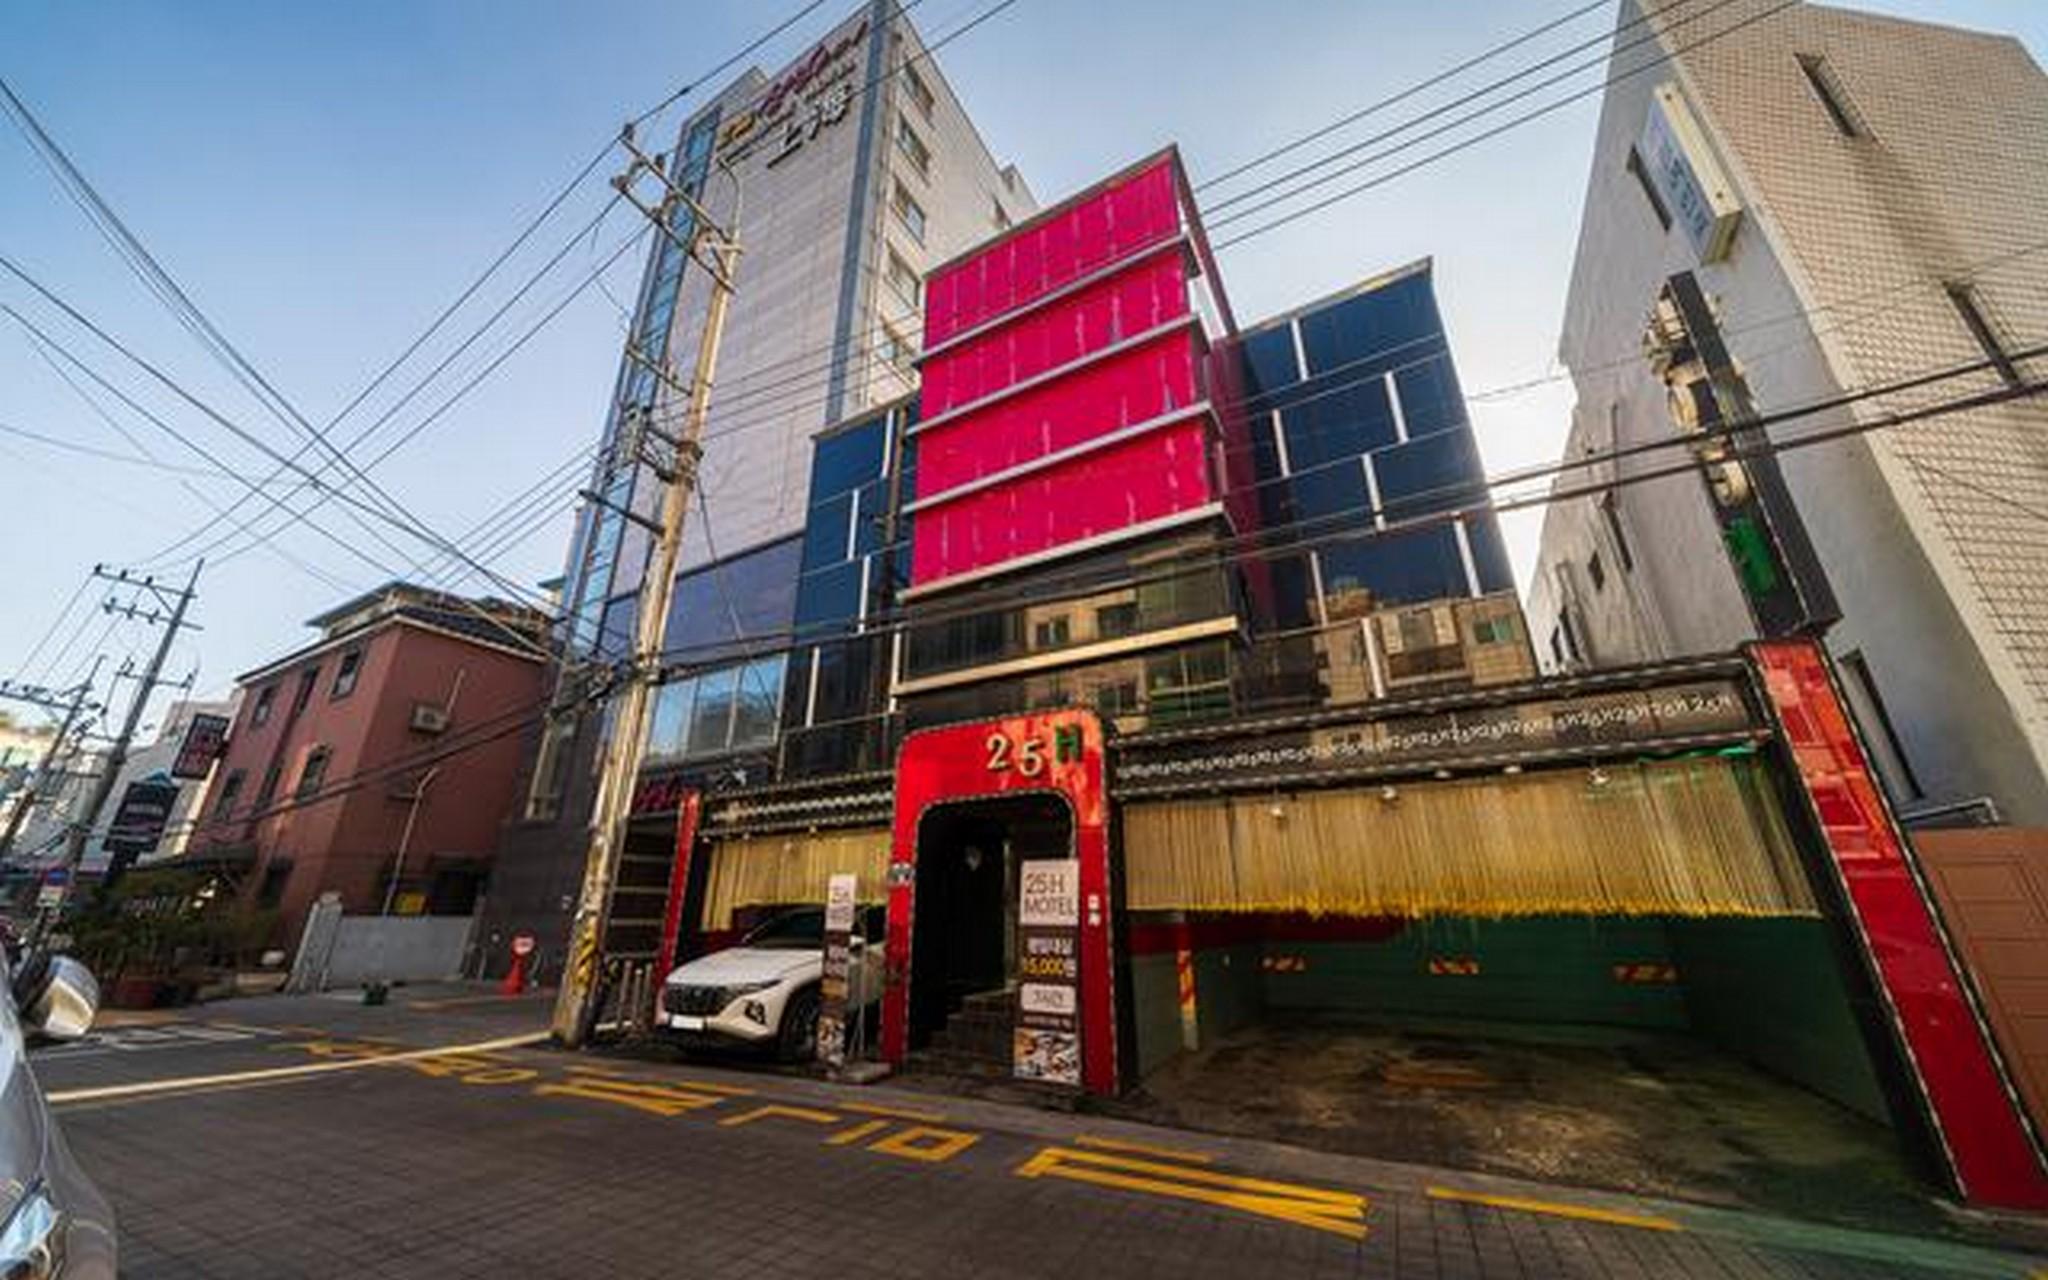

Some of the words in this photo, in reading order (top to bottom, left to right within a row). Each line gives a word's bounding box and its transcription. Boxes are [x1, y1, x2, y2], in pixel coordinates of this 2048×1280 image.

[986, 728, 1083, 776] 25H
[1026, 873, 1064, 893] 25H
[1025, 896, 1075, 916] MOTEL
